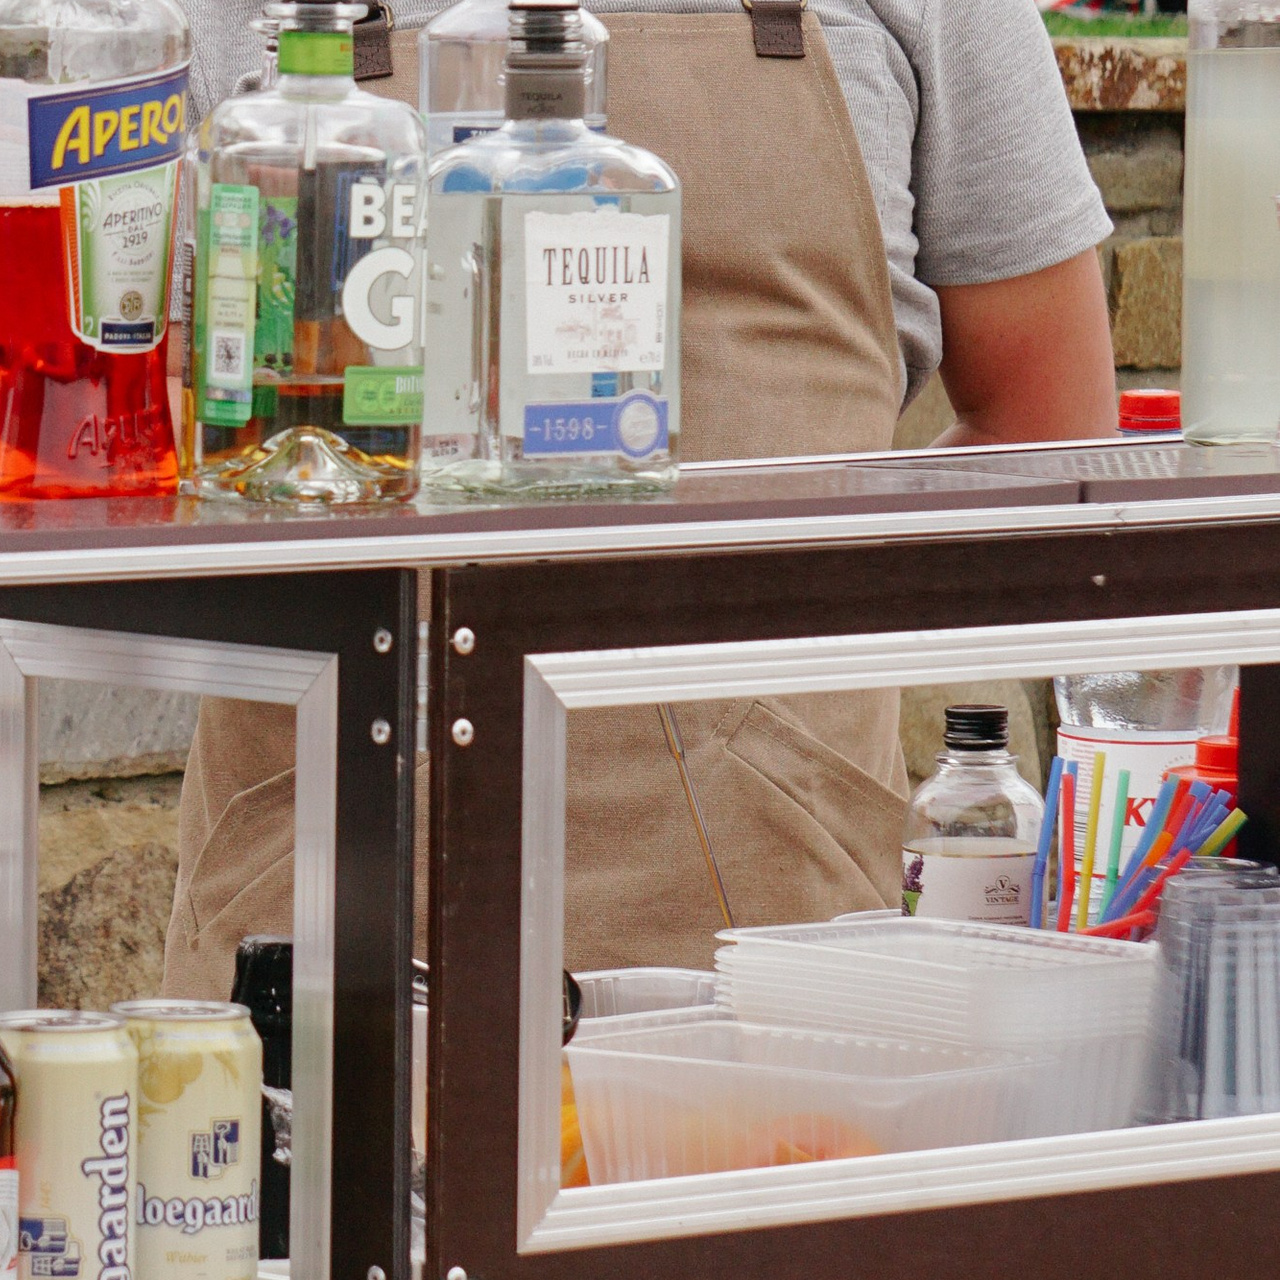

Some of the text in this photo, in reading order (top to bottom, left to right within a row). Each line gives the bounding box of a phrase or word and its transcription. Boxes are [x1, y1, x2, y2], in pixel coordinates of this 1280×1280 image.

[103, 202, 163, 230] APERITIVO
[122, 231, 148, 249] 1919
[128, 225, 144, 234] DAL
[543, 246, 651, 286] TEQUILA
[568, 293, 629, 304] SILVER
[543, 418, 595, 442] 1598
